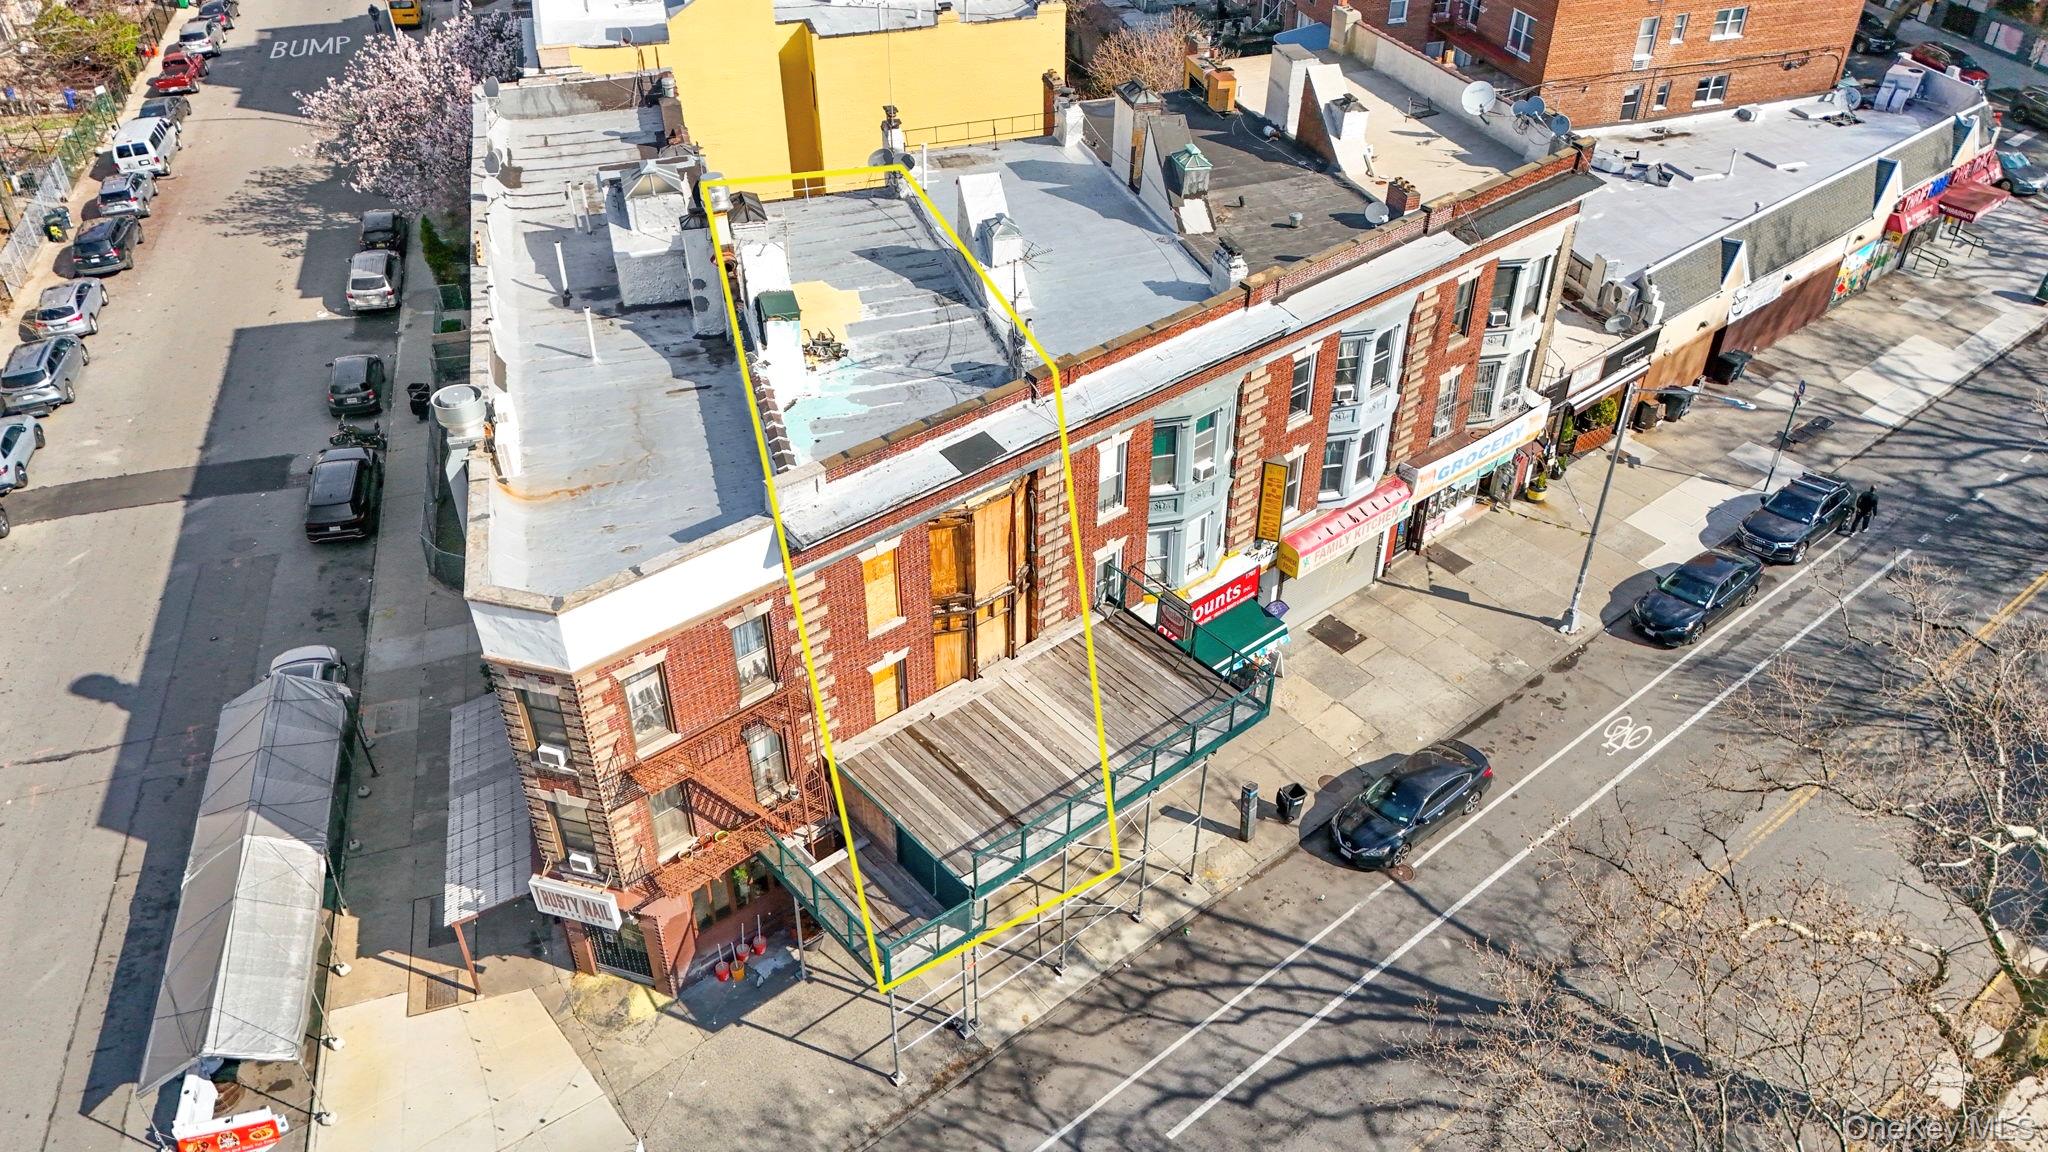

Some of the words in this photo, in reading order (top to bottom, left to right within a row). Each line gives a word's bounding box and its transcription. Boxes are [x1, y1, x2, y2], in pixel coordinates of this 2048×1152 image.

[270, 36, 351, 59] BUMP
[1437, 423, 1525, 481] GROCERY
[1314, 532, 1352, 563] FAMILY
[1354, 507, 1399, 543] KITCHEN
[1192, 583, 1241, 621] ounts
[540, 889, 579, 914] RUSTY
[582, 900, 613, 922] NAIL
